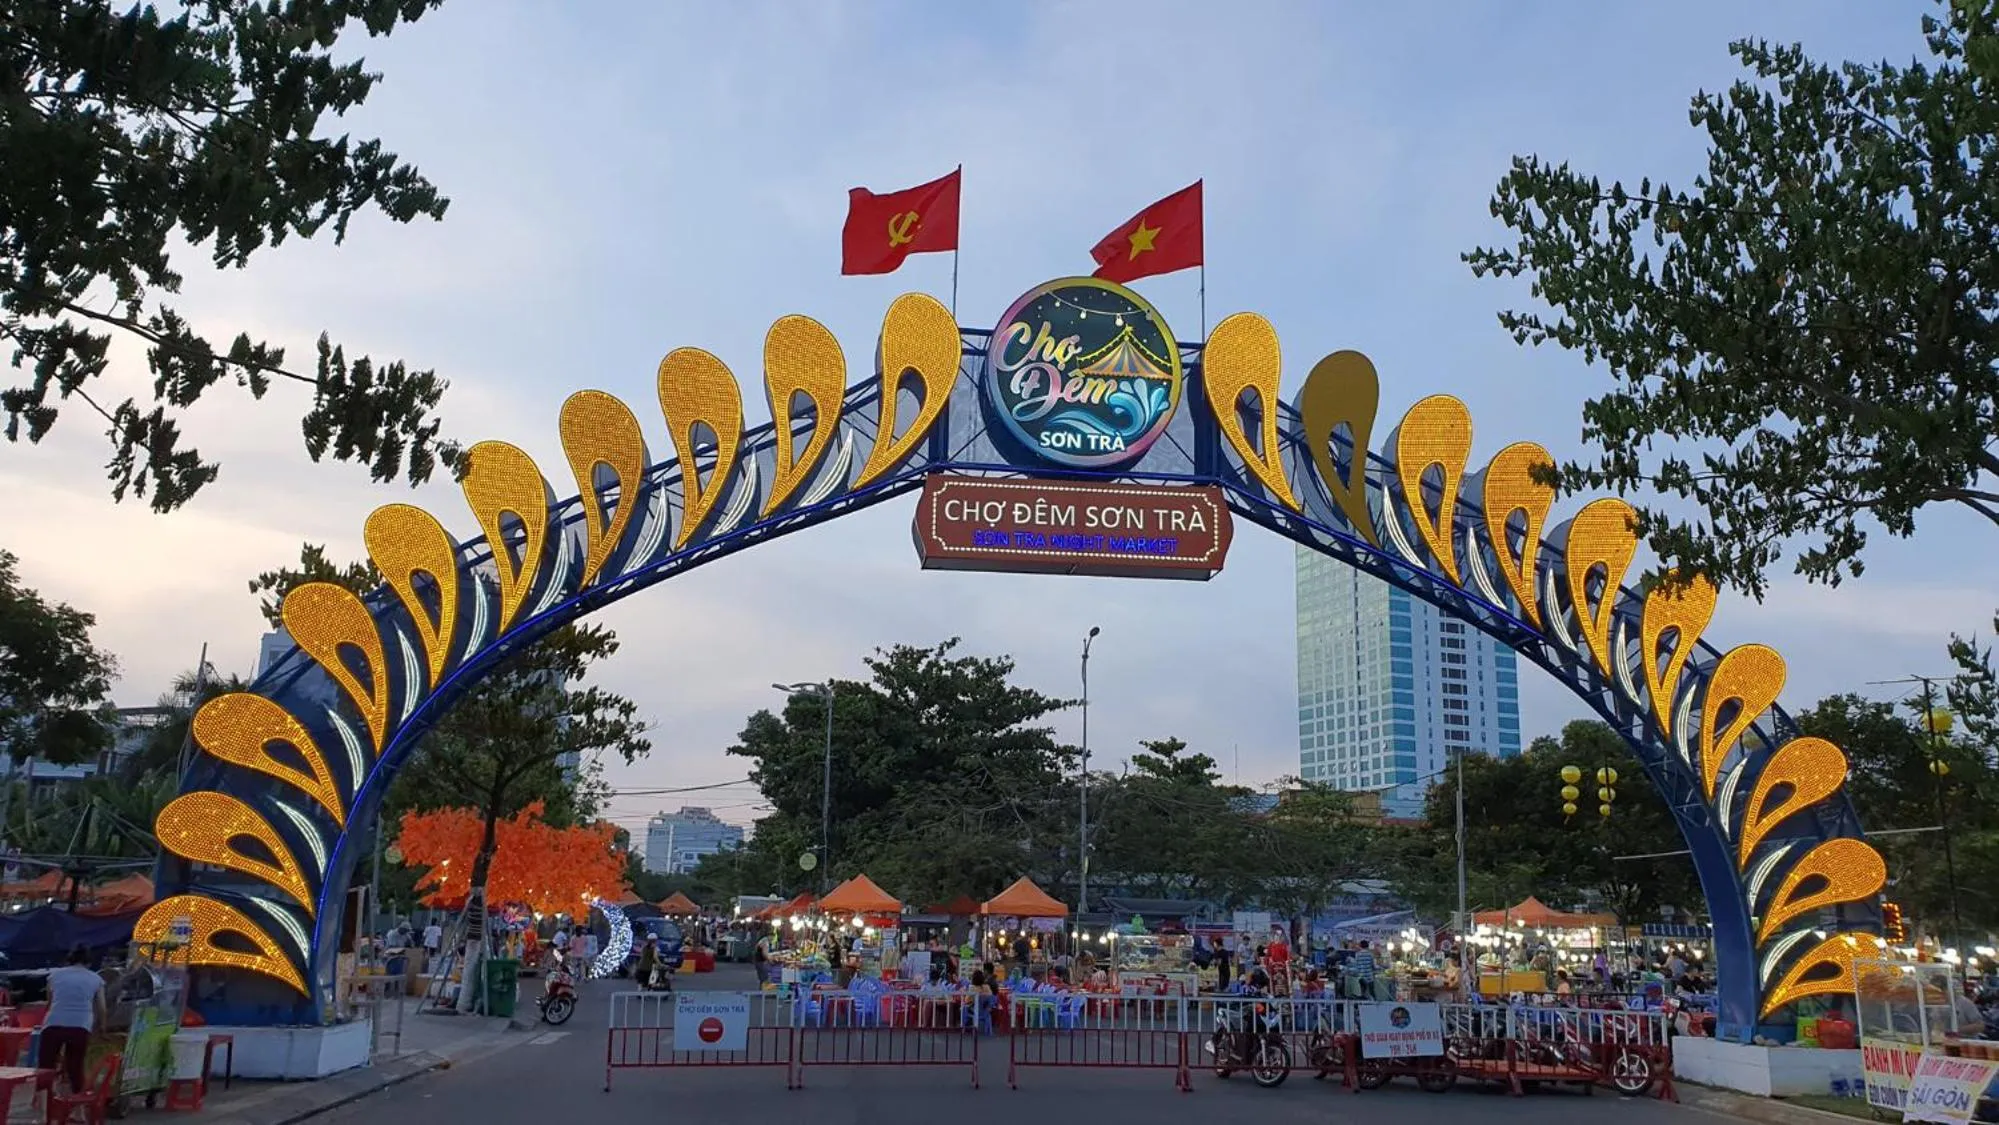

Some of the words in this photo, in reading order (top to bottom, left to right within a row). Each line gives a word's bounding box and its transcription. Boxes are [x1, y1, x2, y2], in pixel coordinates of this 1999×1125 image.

[997, 321, 1082, 371] Chợ
[1010, 363, 1118, 421] Đêm
[1040, 430, 1081, 449] SƠN
[1088, 431, 1125, 451] TRÀ
[944, 499, 1006, 527] CHỢ
[1012, 497, 1076, 526] ĐÊM
[1085, 506, 1144, 528] SƠN
[1154, 504, 1206, 532] TRÀ
[972, 530, 1009, 546] SON
[1015, 532, 1045, 547] TRA
[1051, 534, 1104, 550] NIGHT
[1109, 536, 1178, 553] MARKET
[1911, 1083, 1932, 1105] SÀI
[1932, 1086, 1971, 1111] GÒN
